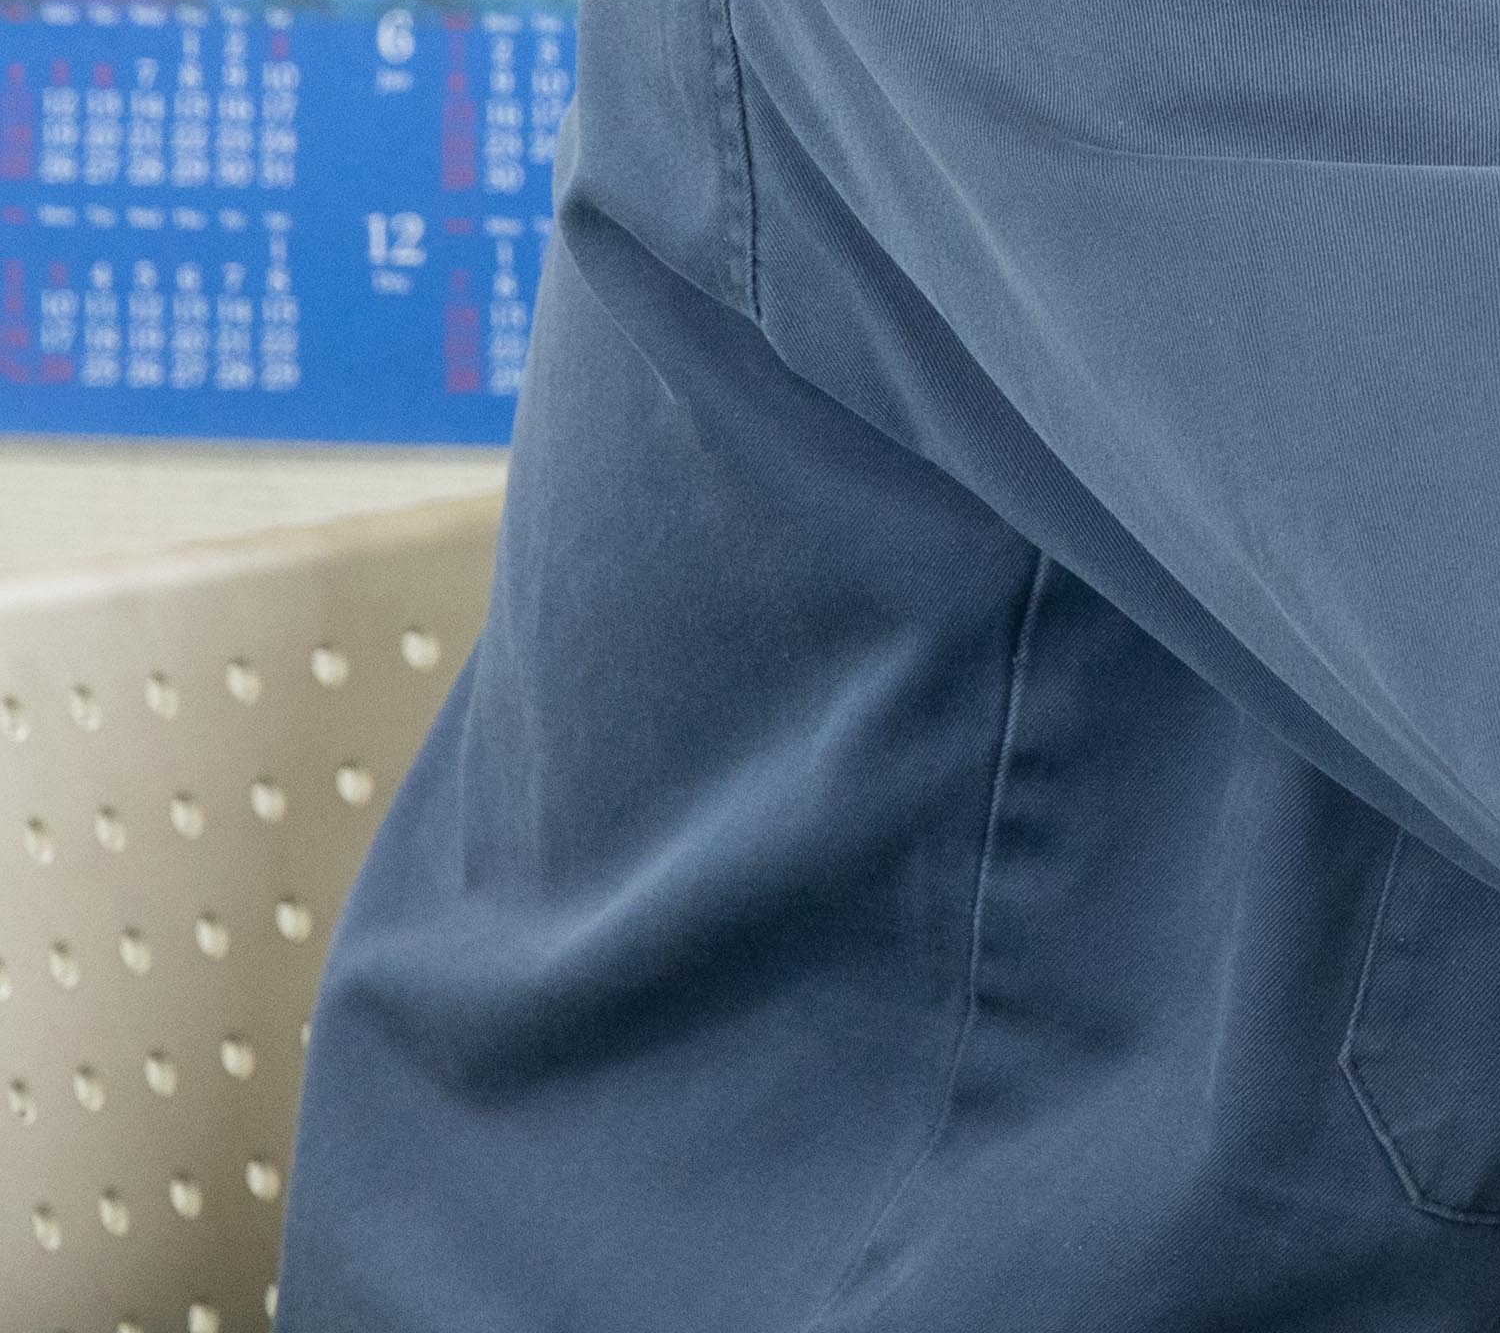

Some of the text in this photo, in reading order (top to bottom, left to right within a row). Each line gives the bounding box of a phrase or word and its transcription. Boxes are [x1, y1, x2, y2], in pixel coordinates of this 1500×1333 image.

[377, 10, 416, 64] 6
[134, 57, 159, 88] 7
[262, 61, 299, 90] 10
[367, 212, 427, 268] 12
[222, 262, 247, 293] 7
